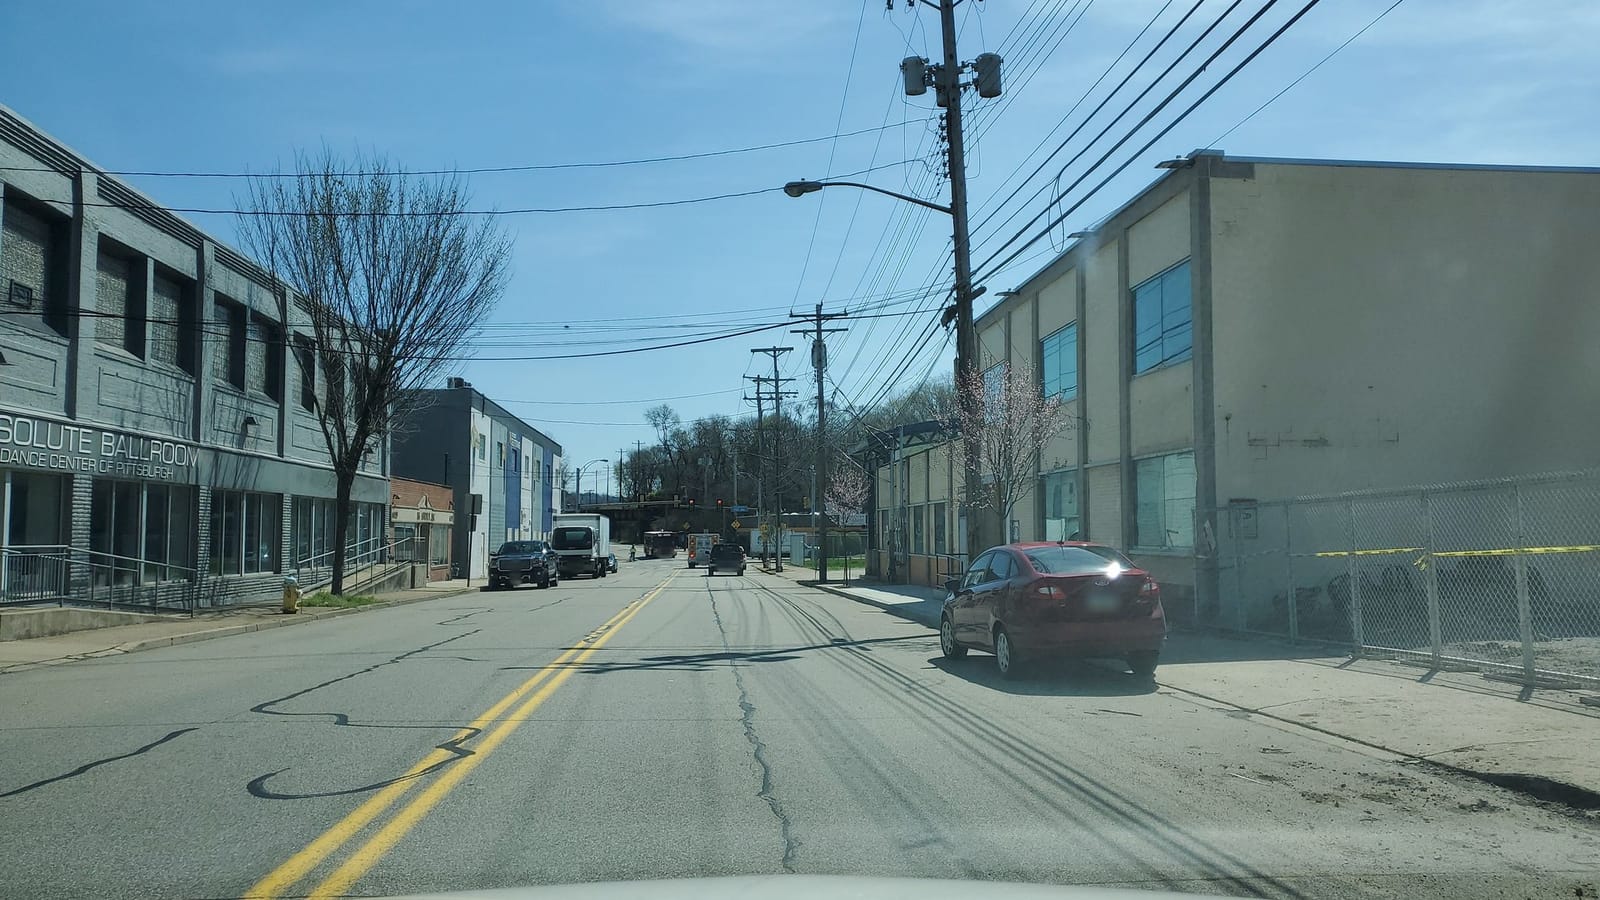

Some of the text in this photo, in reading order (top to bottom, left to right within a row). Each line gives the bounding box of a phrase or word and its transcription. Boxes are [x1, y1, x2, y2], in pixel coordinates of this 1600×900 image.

[0, 448, 174, 480] DANCE CENTER OF PITTSBURGH
[101, 431, 200, 468] BALLROOM
